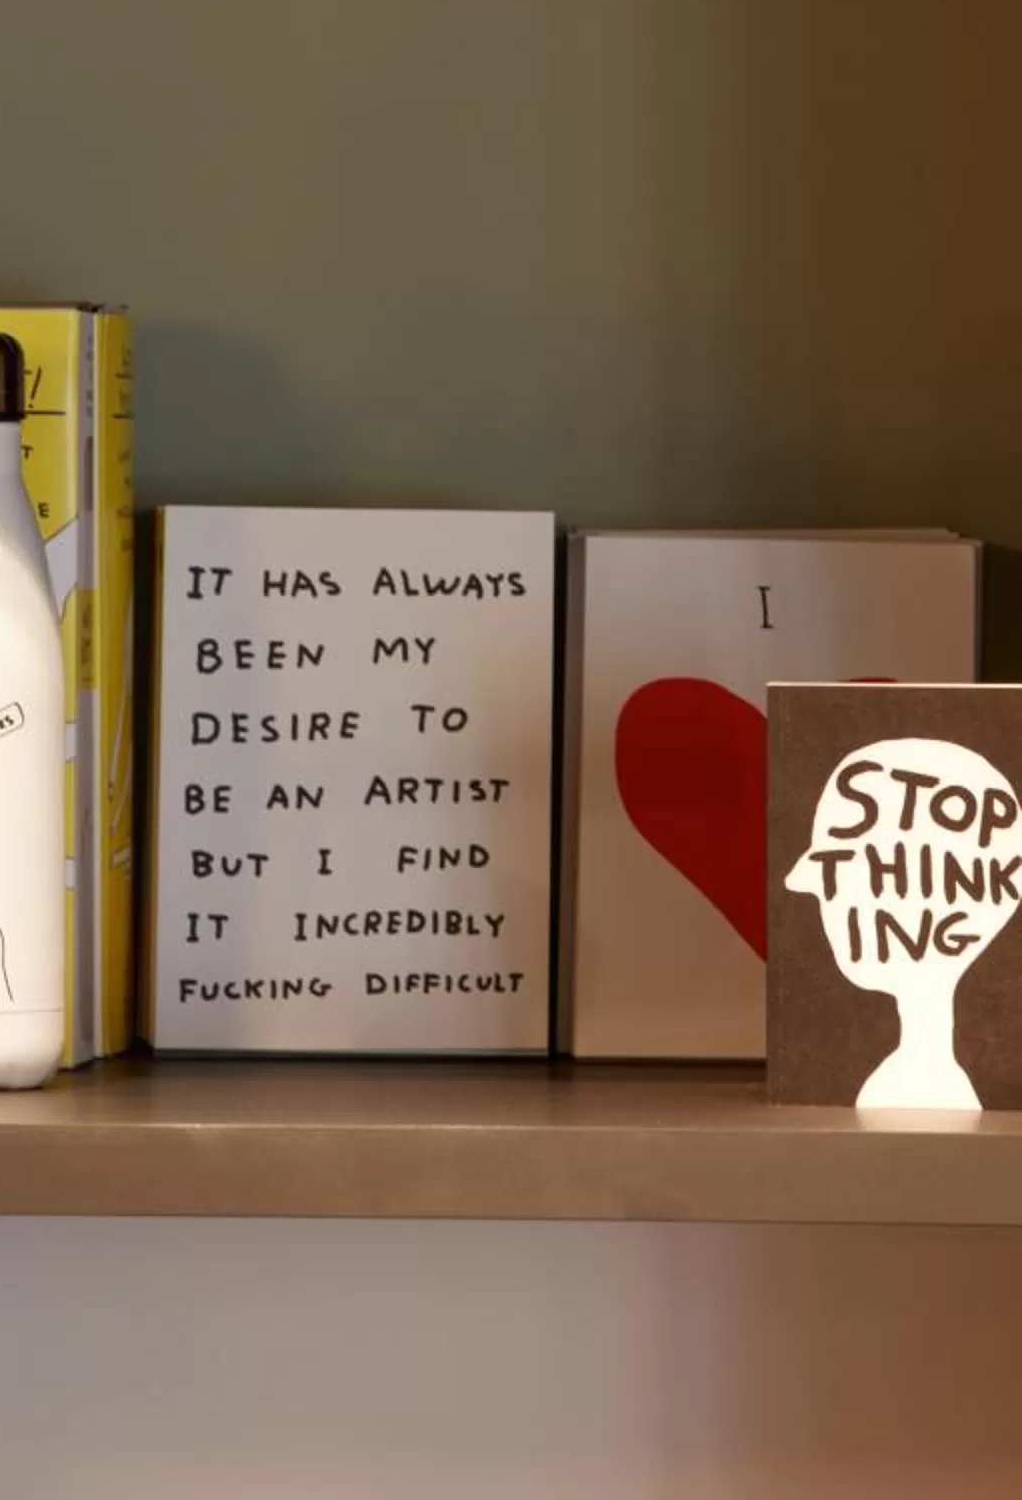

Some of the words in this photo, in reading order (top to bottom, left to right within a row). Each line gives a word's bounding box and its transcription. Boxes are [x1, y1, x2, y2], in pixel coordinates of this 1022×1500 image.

[186, 566, 232, 599] IT
[263, 570, 341, 598] HAS
[373, 567, 527, 600] ALWAYS
[756, 586, 774, 629] I
[196, 638, 324, 675] BEEN
[373, 637, 436, 665] MY
[191, 711, 361, 746] DESIRE
[411, 704, 468, 733] TO
[184, 783, 232, 815] BE
[267, 784, 324, 810] AN
[364, 775, 511, 805] ARTIST
[828, 759, 1018, 849] STOP
[191, 850, 269, 878] BUT
[317, 849, 333, 876] I
[398, 843, 490, 873] FIND
[809, 842, 1022, 906] THINK
[186, 913, 229, 942] IT
[294, 910, 506, 941] INCREDIBLY
[848, 906, 981, 965] ING
[179, 978, 332, 1003] FUCKING
[365, 972, 524, 996] DIFFICULT
